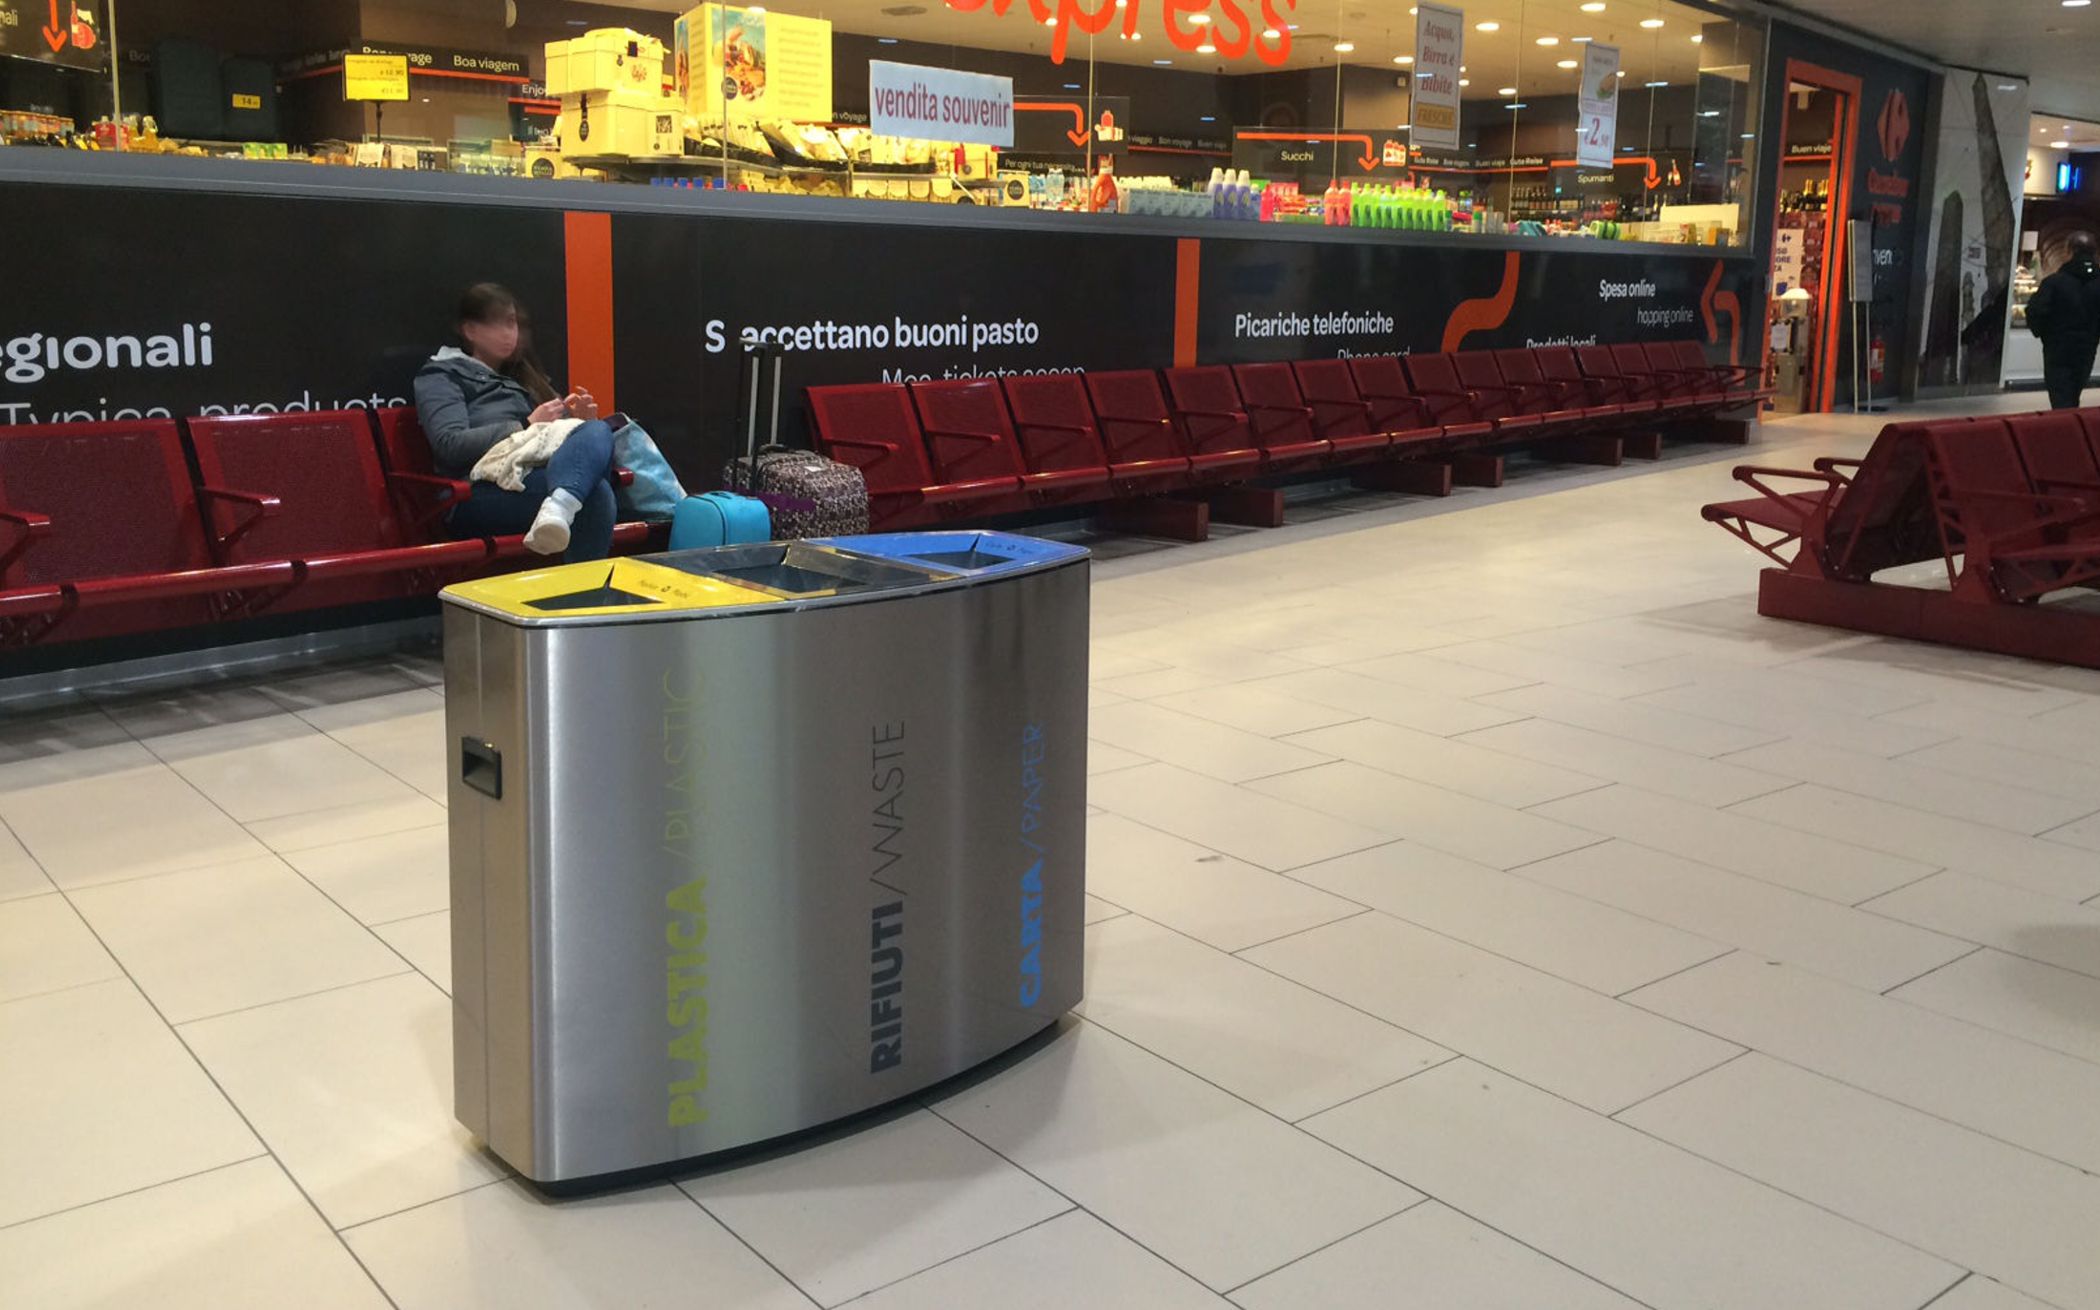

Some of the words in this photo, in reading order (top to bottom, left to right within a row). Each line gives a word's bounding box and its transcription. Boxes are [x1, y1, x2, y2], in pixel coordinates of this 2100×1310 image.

[947, 0, 1298, 66] press
[454, 55, 476, 68] Boa
[478, 58, 520, 73] viagem
[875, 82, 938, 121] vendita
[943, 93, 1011, 128] souvenir
[839, 112, 867, 124] voyage
[1281, 150, 1314, 162] Succhi
[1577, 173, 1615, 186] Spumanti
[1599, 279, 1627, 302] Spesa
[1628, 278, 1656, 298] online
[1235, 313, 1309, 338] Picariche
[1313, 310, 1394, 336] telefoniche
[1671, 306, 1694, 323] online
[741, 319, 889, 352] accettano
[895, 315, 968, 347] buoni
[973, 317, 1039, 353] pasto
[0, 322, 213, 384] gionali
